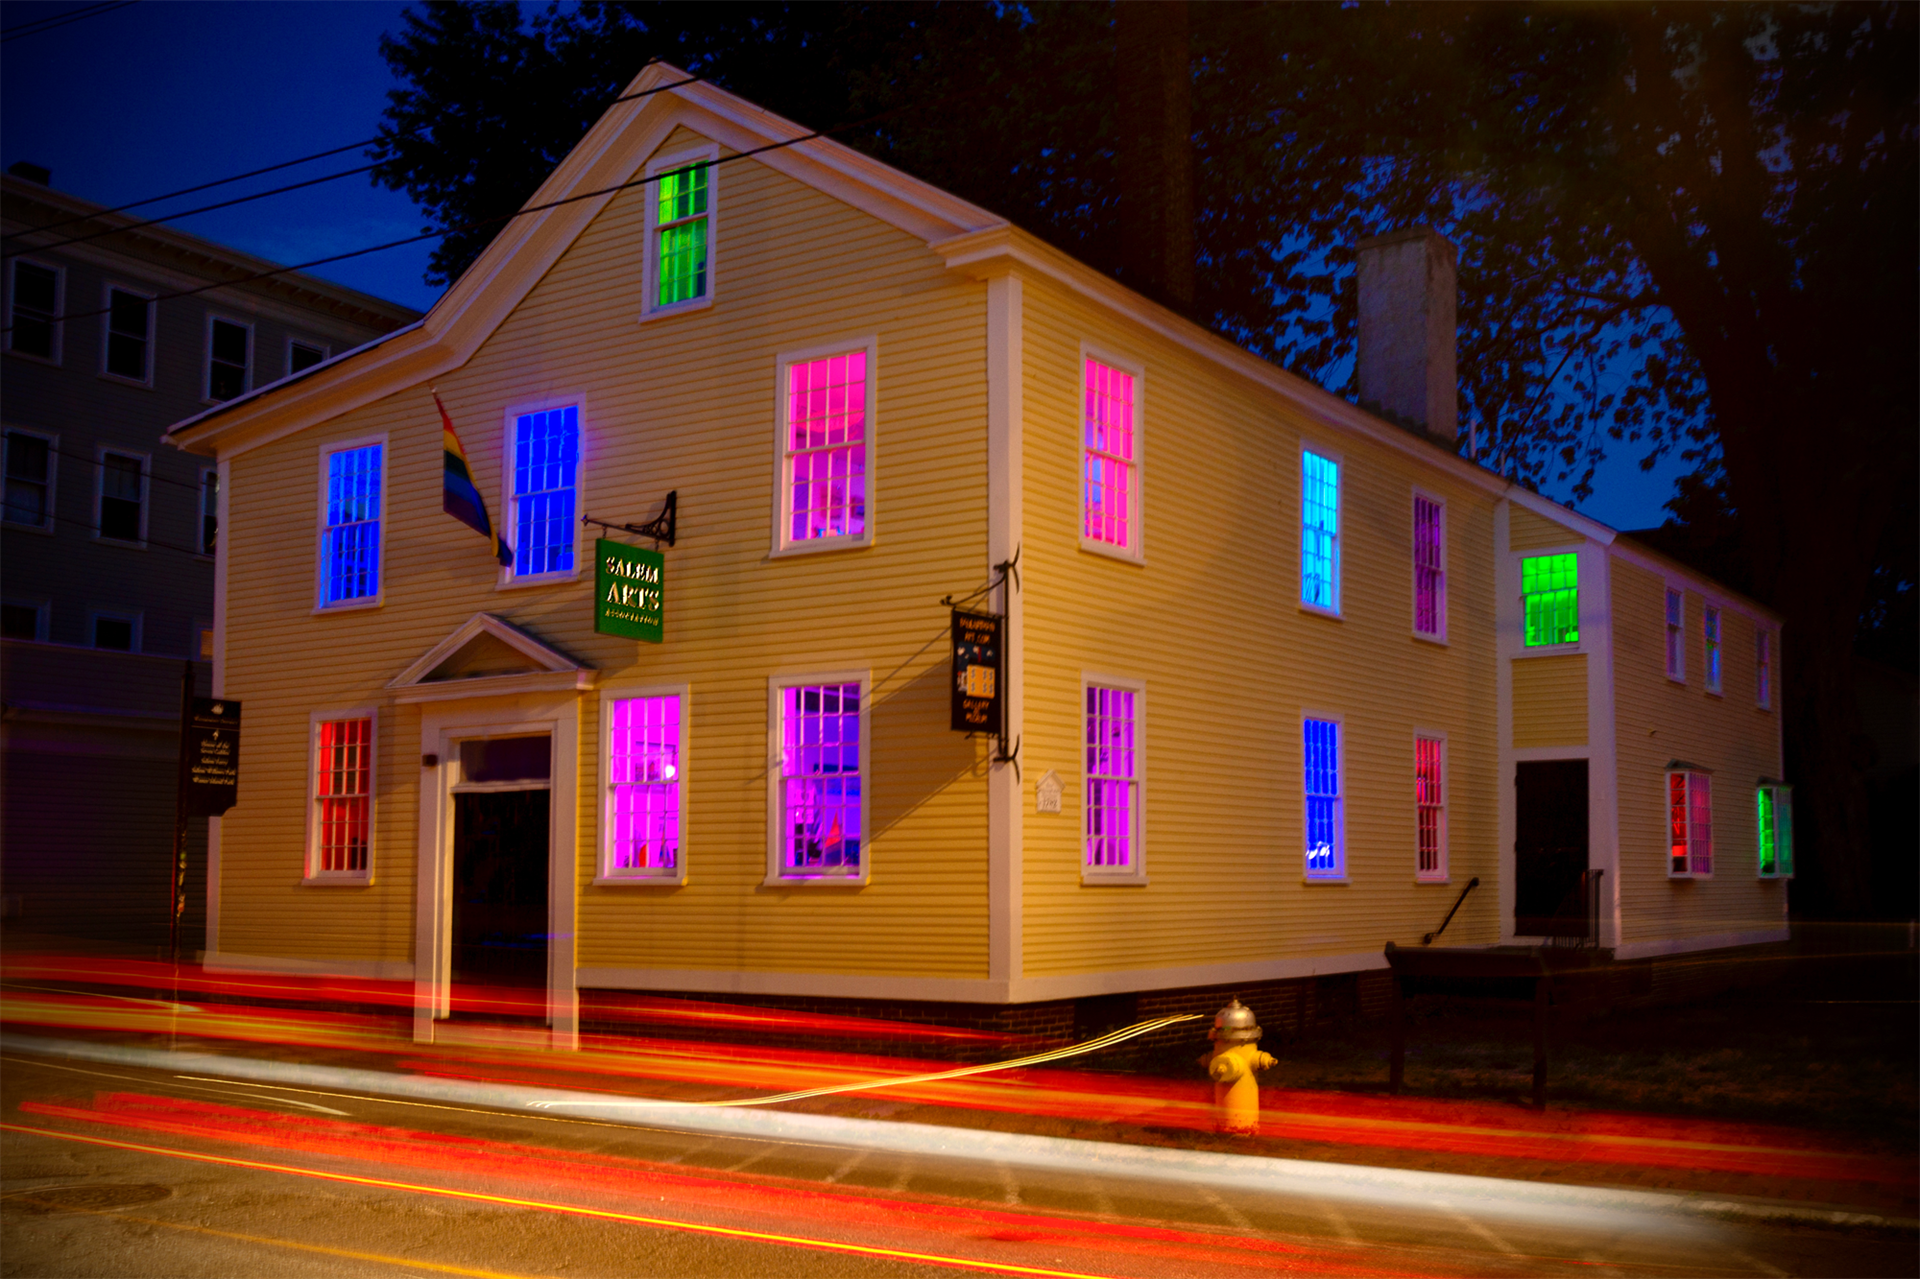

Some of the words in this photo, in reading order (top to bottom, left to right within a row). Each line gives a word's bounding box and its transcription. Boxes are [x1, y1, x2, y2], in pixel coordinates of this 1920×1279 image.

[605, 556, 659, 585] SALEM
[606, 581, 660, 612] ARTS
[605, 608, 660, 626] ASSOCIATION
